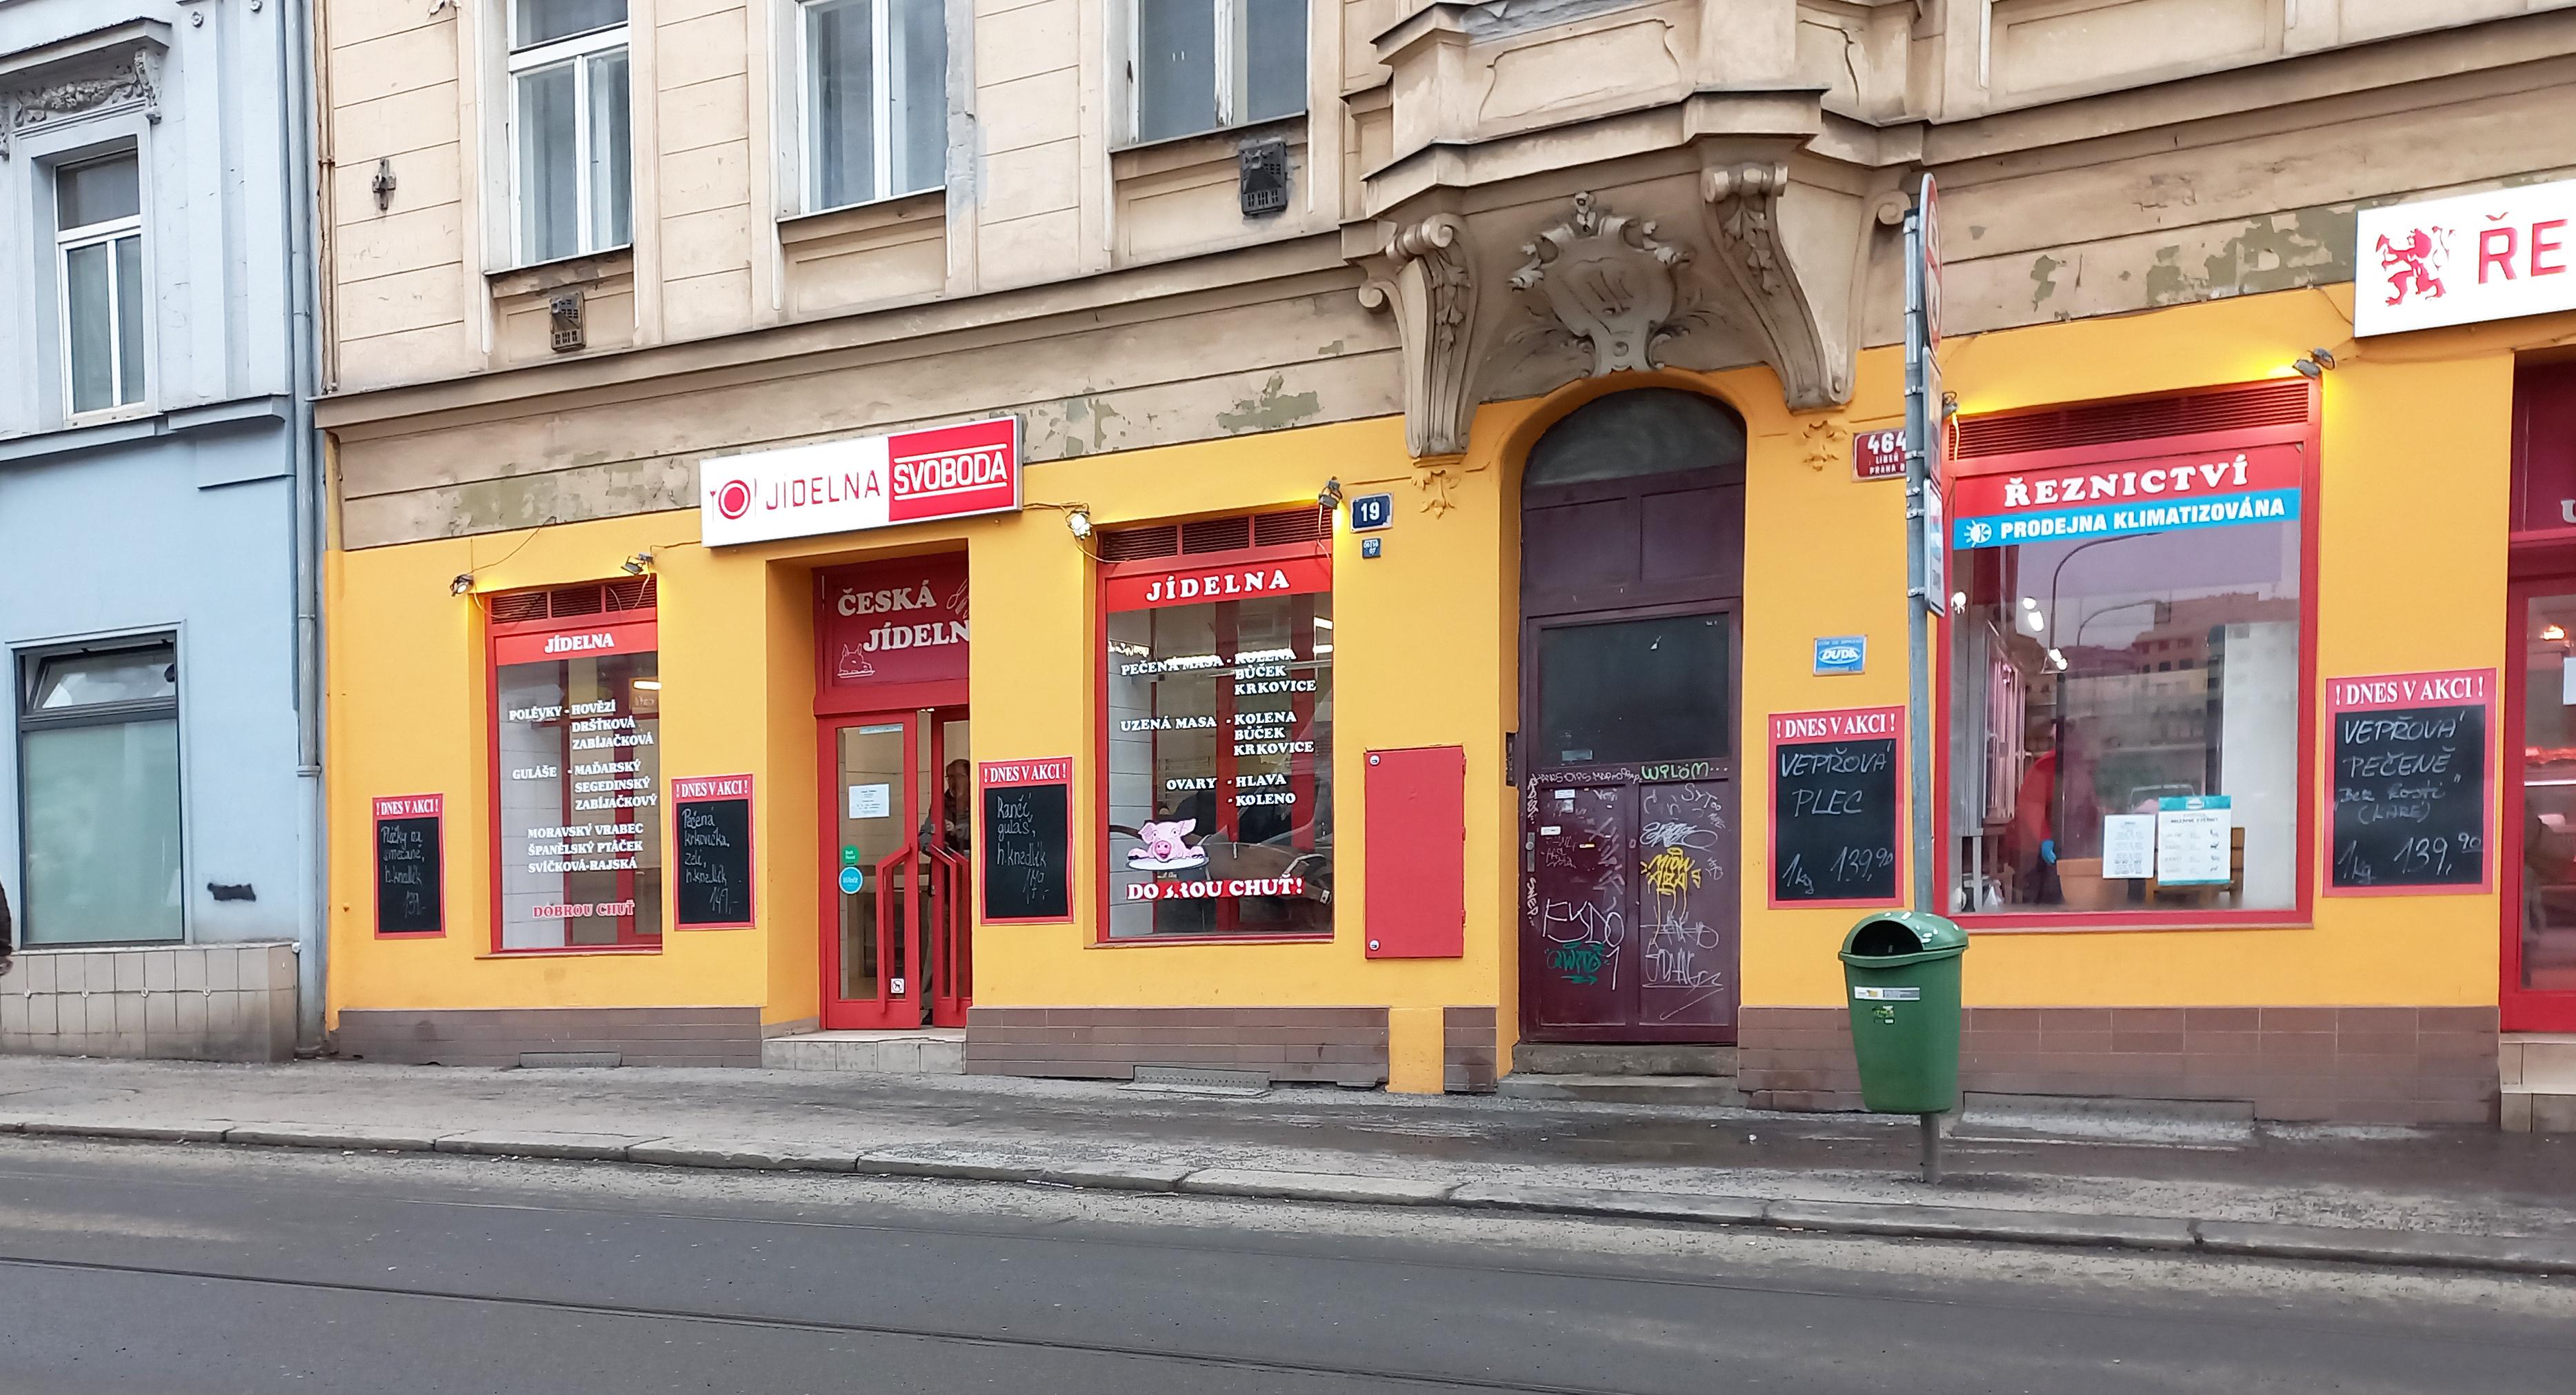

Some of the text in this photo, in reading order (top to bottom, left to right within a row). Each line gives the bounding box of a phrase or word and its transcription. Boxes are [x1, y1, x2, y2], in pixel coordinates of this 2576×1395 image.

[1868, 431, 1906, 455] 464
[893, 451, 1008, 494] SVOBODA
[2004, 453, 2248, 508] ŘEZNICTVÍ
[1361, 502, 1380, 522] 19
[2001, 496, 2285, 540] PRODEJNA KLIMATIZOVÁNA
[1145, 569, 1290, 602] JÍDELNA
[837, 580, 937, 616] ČESKÁ
[544, 633, 615, 653] JÍDELNA
[1234, 680, 1317, 695] KRKOVICE
[2346, 682, 2398, 706] DNES
[2403, 681, 2417, 701] V
[2420, 677, 2472, 700] AKCI
[509, 706, 562, 722] POLÉVKY
[571, 699, 616, 715] HOVĚZÍ
[572, 715, 635, 733] DRŠŤKOVÁ
[1120, 715, 1172, 732] UZENÁ
[1175, 716, 1217, 730] MASA
[1234, 711, 1297, 726] KOLENA
[1785, 718, 1826, 738] DNES
[1830, 716, 1841, 735] V
[1844, 713, 1886, 735] AKCI
[2345, 710, 2466, 744] VEPŘOVÁ
[572, 732, 654, 750] ZABÍJAČKOVÁ
[1234, 726, 1286, 741] BŮČEK
[1233, 741, 1314, 756] KRKOVICE
[1781, 740, 1892, 778] VEPŘOVÁ
[512, 765, 557, 780] GULÁŠE
[574, 759, 641, 775] MAĎARSKÝ
[990, 766, 1019, 782] DNES
[1021, 765, 1030, 781] V
[1031, 763, 1060, 780] AKCI
[575, 776, 651, 793] SEGEDINSKÝ
[681, 782, 707, 798] DNES
[708, 781, 716, 796] V
[717, 780, 742, 795] AKCI
[1166, 777, 1217, 790] OVARY
[1235, 773, 1286, 788] HLAVA
[381, 801, 403, 815] DNES
[404, 800, 412, 813] V
[412, 799, 435, 813] AKCI
[575, 793, 657, 811] ZABÍJAČKOVÝ
[1235, 793, 1296, 807] KOLENO
[1792, 789, 1863, 818] PLEC
[528, 823, 643, 839] MORAVSKÝ VRABEC
[528, 840, 643, 856] ŠPANĚLSKÝ PTÁČEK
[1228, 873, 1303, 896] CHUŤ!
[532, 900, 635, 918] DOBROU CHUŤ
